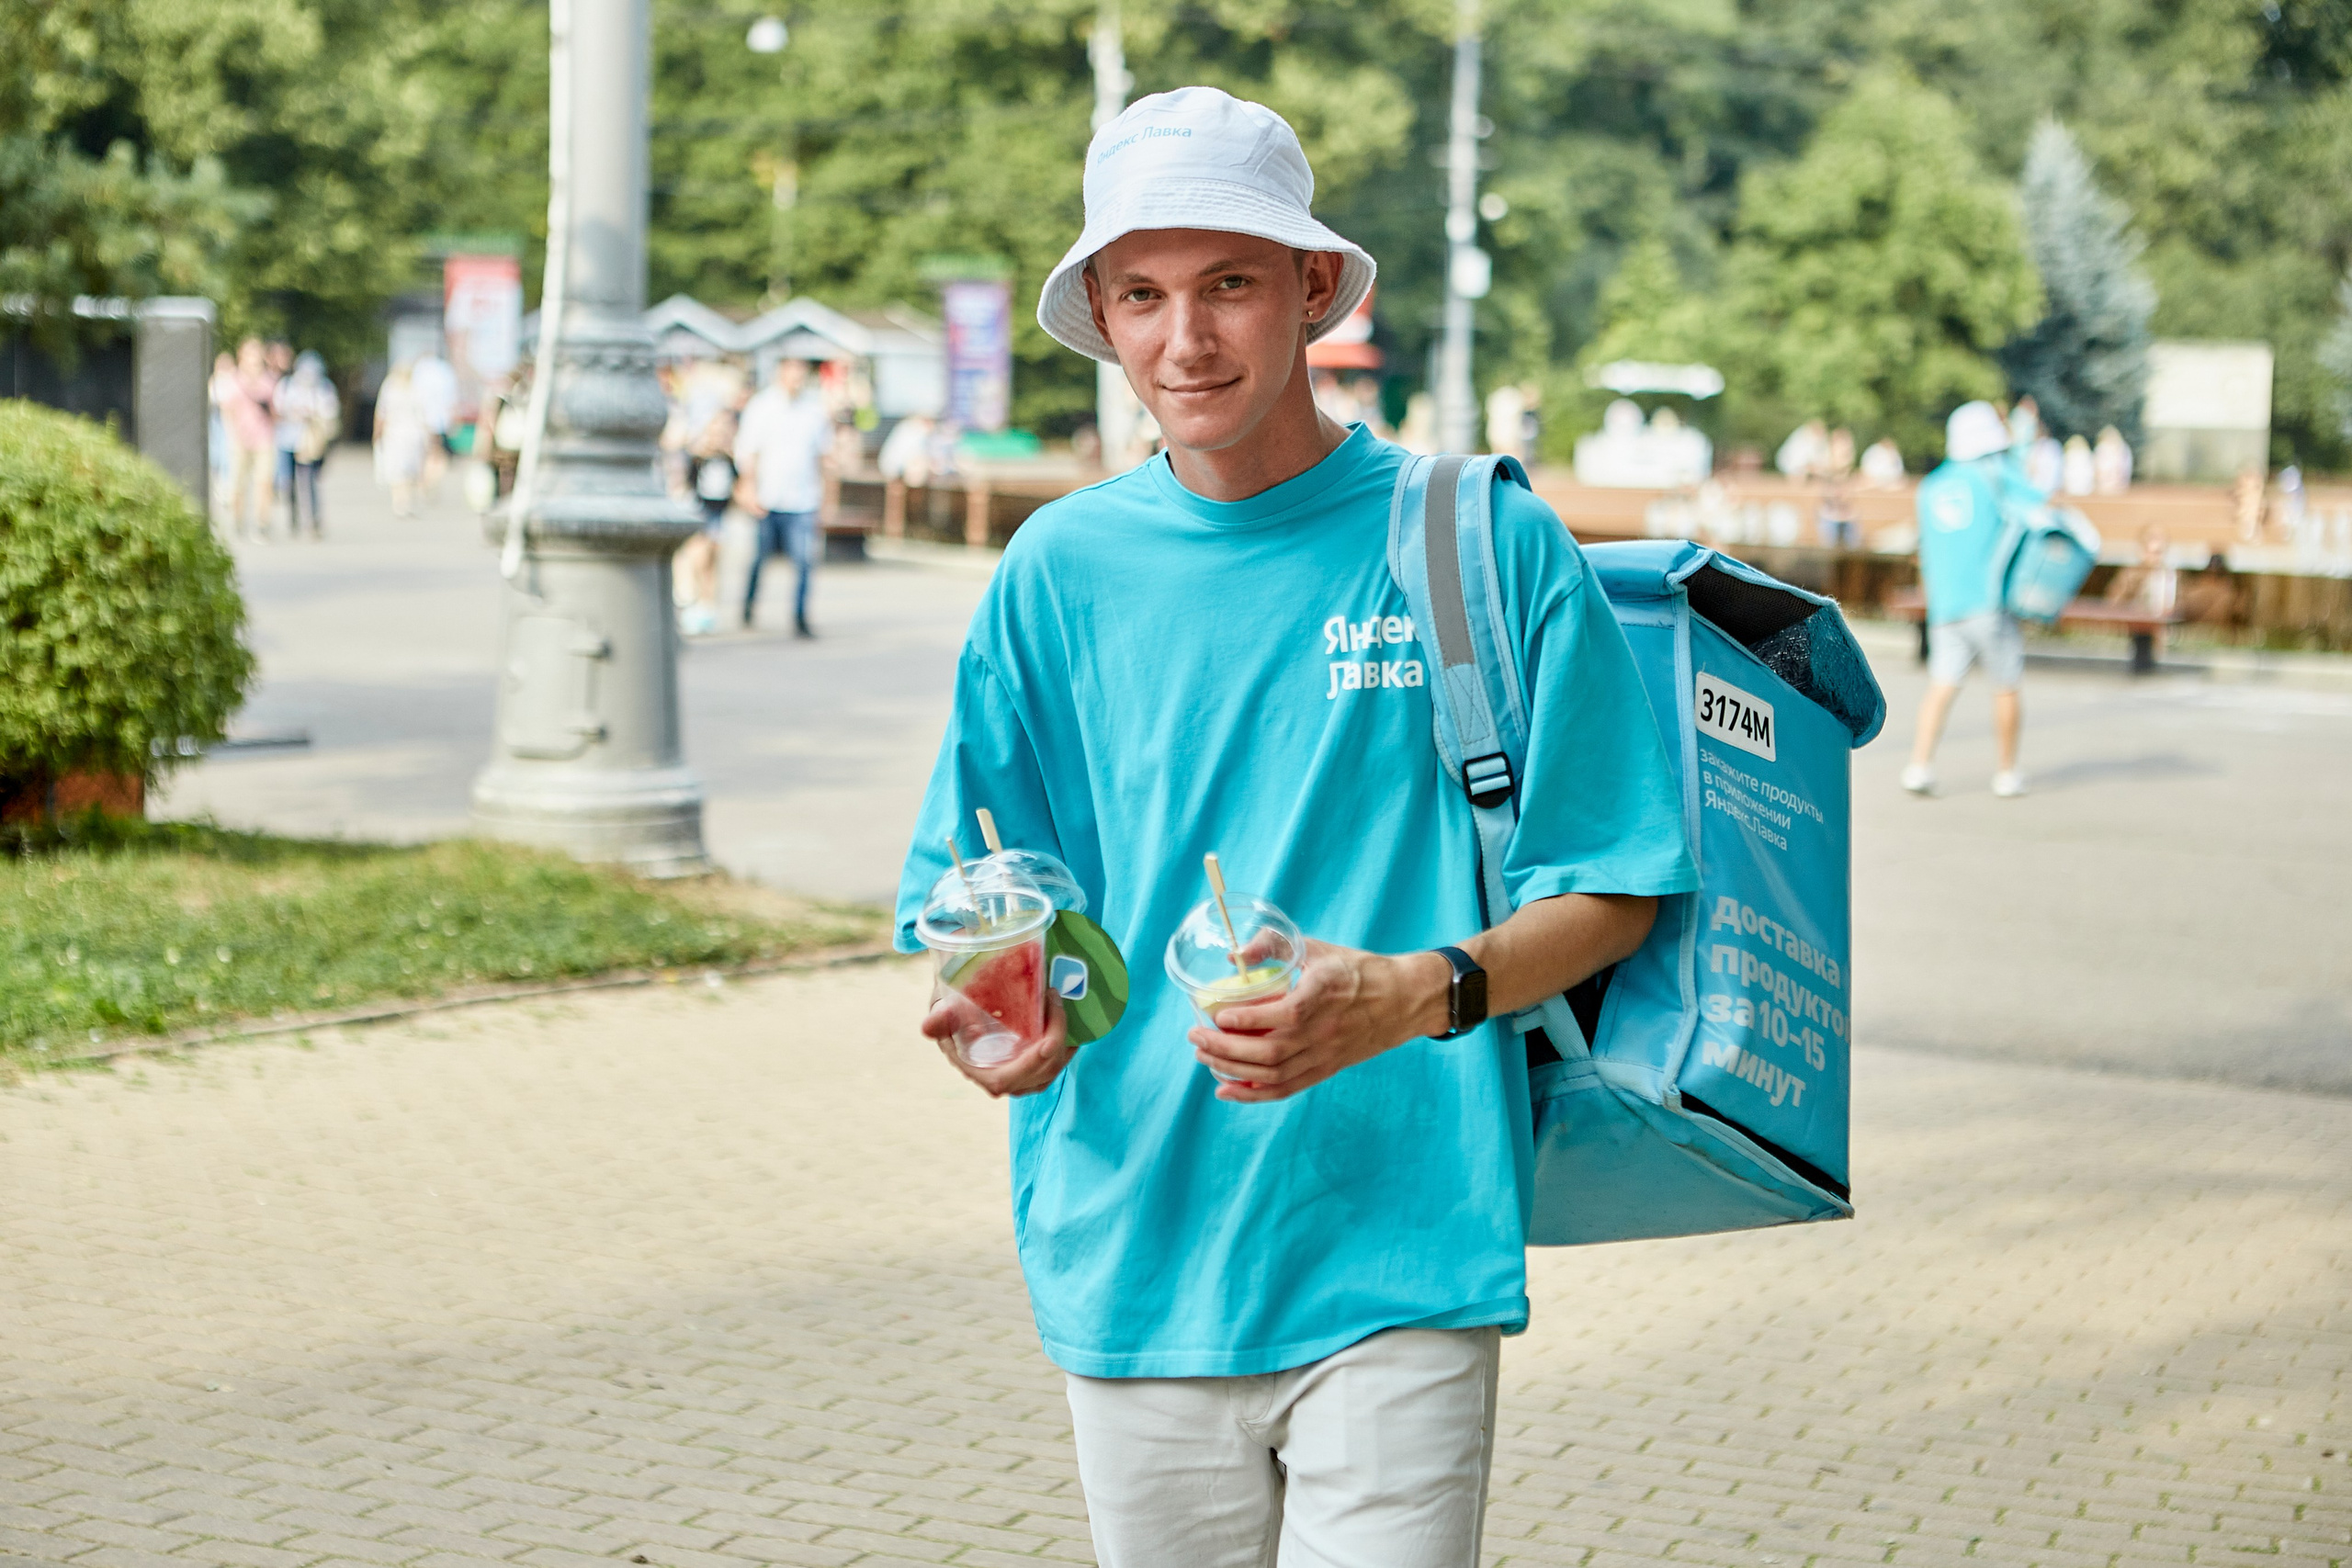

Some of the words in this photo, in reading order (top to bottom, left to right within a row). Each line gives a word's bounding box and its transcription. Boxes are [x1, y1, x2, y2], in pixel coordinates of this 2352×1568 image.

[1141, 126, 1193, 141] Лавка
[1323, 615, 1421, 655] Яндек
[1326, 660, 1424, 700] Лавка
[1700, 688, 1770, 749] 3174M
[1700, 748, 1759, 793] закажите
[1761, 782, 1824, 825] продукты
[1703, 770, 1713, 785] в
[1715, 774, 1792, 830] приложении
